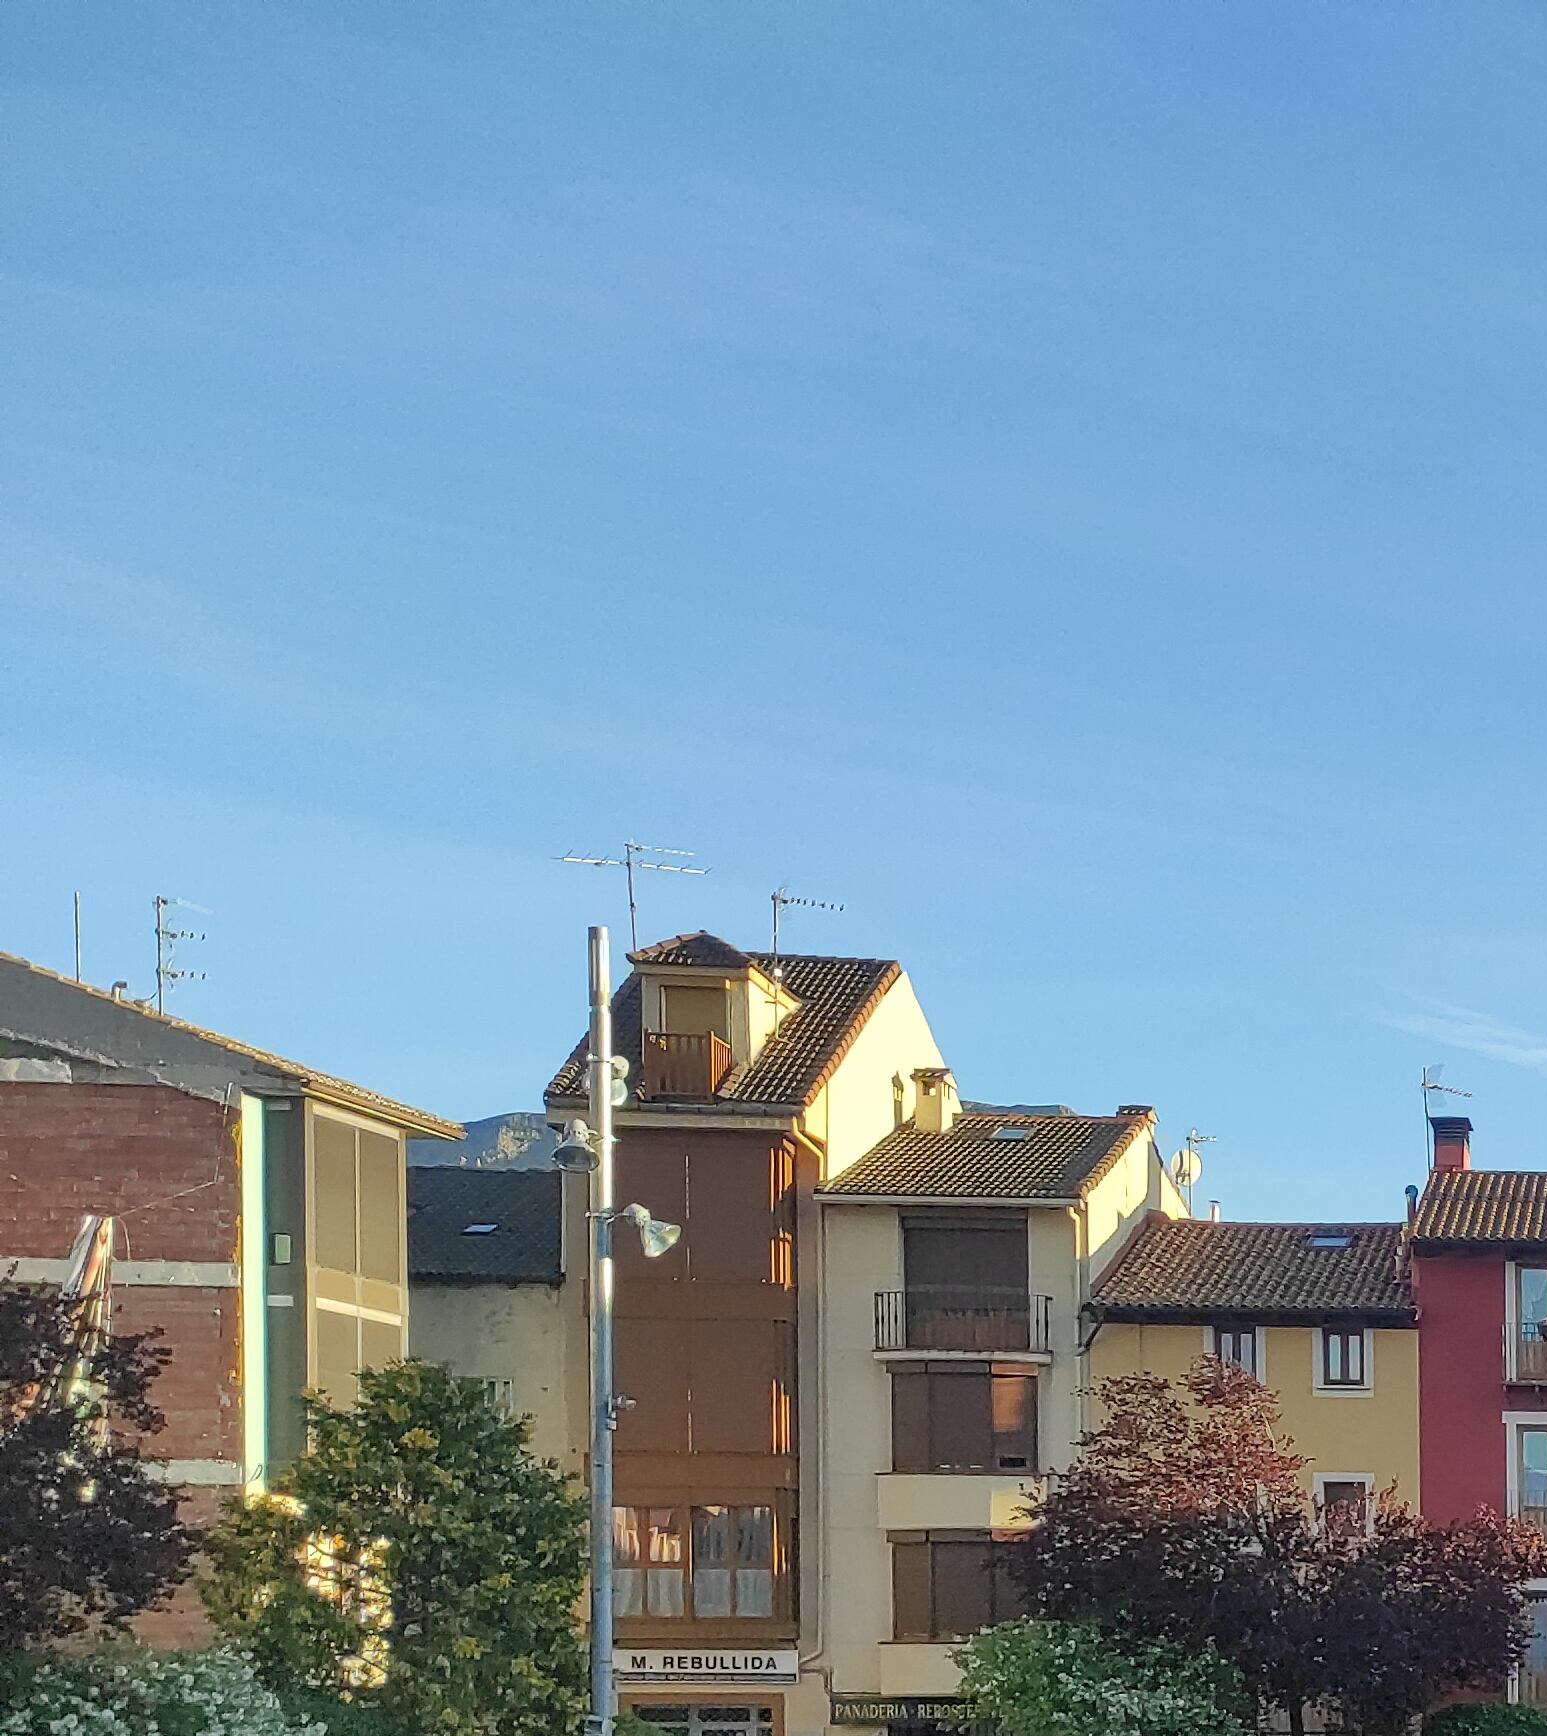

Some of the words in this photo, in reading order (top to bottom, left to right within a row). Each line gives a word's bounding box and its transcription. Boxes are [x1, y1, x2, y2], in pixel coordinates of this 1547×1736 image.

[631, 1656, 653, 1670] M.
[663, 1656, 777, 1670] REBULLIDA
[835, 1703, 909, 1719] PANADERIA
